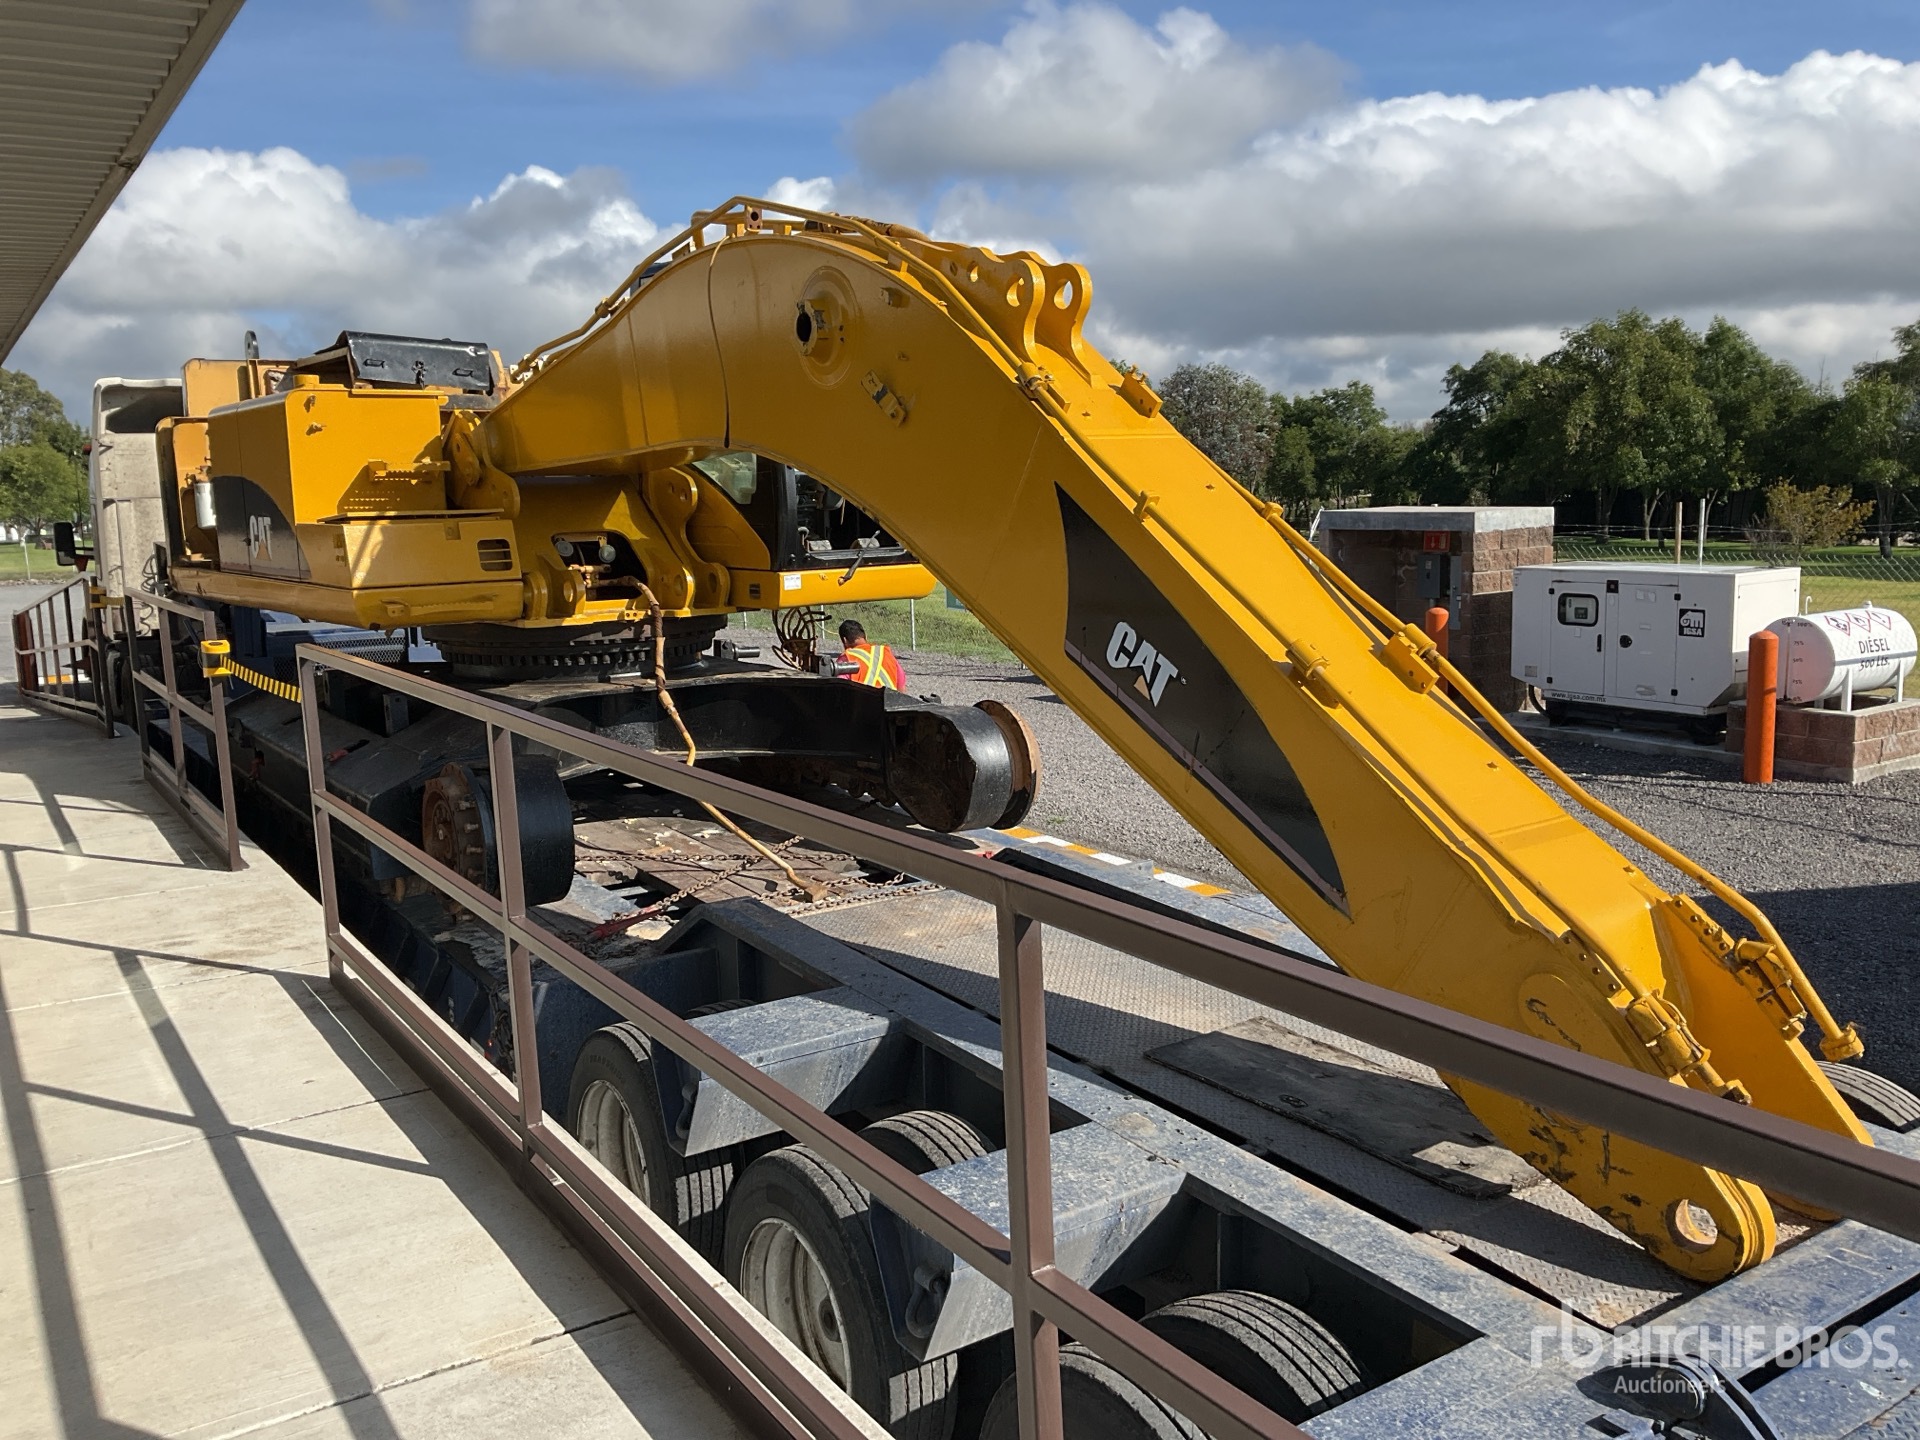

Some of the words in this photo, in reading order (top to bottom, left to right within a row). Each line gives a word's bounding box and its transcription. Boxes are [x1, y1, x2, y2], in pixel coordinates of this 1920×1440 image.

[249, 515, 272, 560] CAT
[1683, 627, 1702, 636] IGSA
[1106, 621, 1179, 707] CAT
[1859, 659, 1875, 671] 500
[1551, 692, 1607, 703] www.igsa.com.mx
